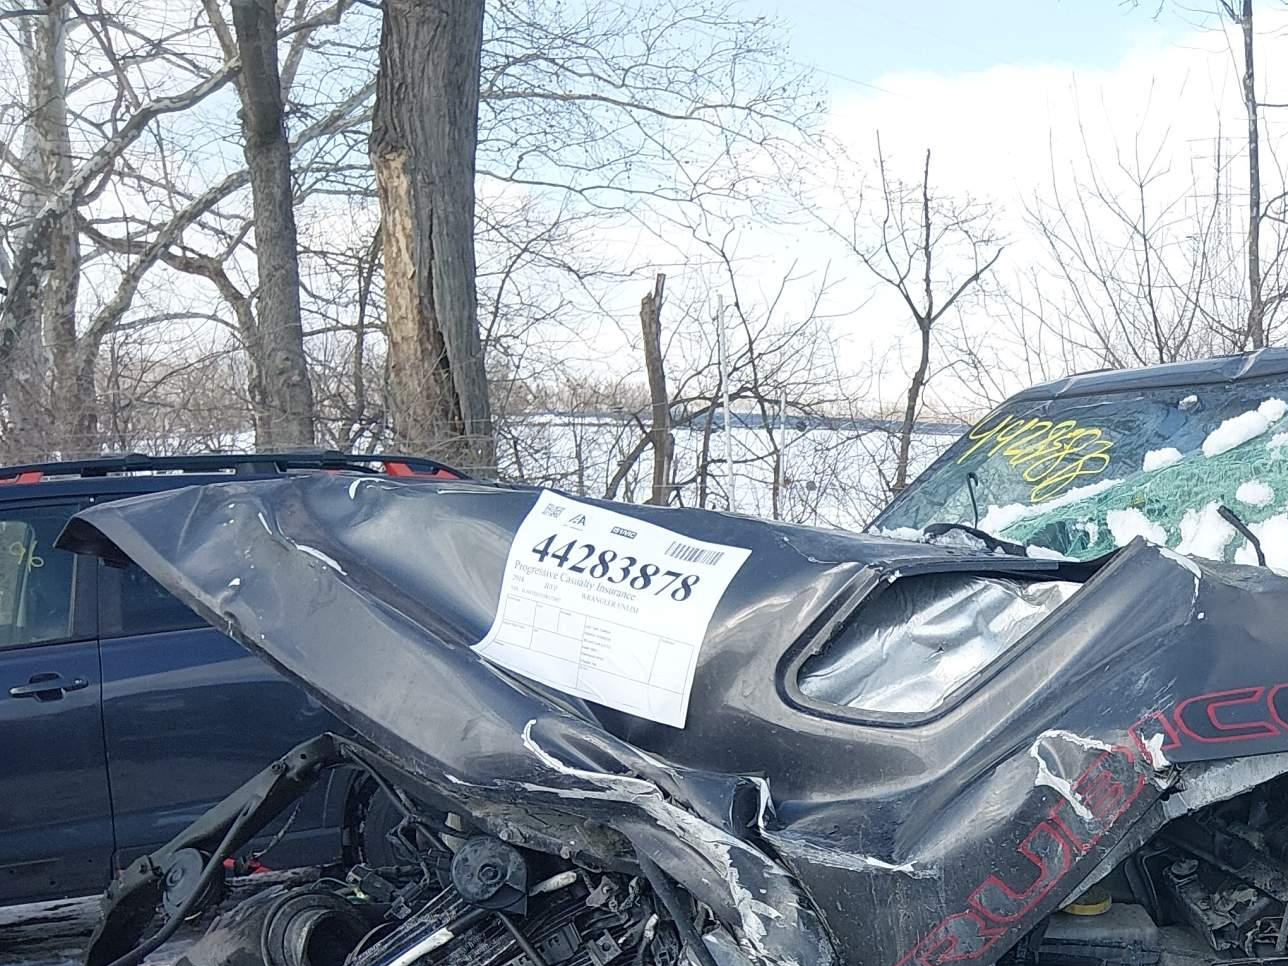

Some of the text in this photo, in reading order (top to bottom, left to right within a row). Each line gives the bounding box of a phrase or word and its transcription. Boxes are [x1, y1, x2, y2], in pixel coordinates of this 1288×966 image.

[514, 559, 637, 602] Progressive Casualty Insurance
[532, 533, 700, 602] 44283878
